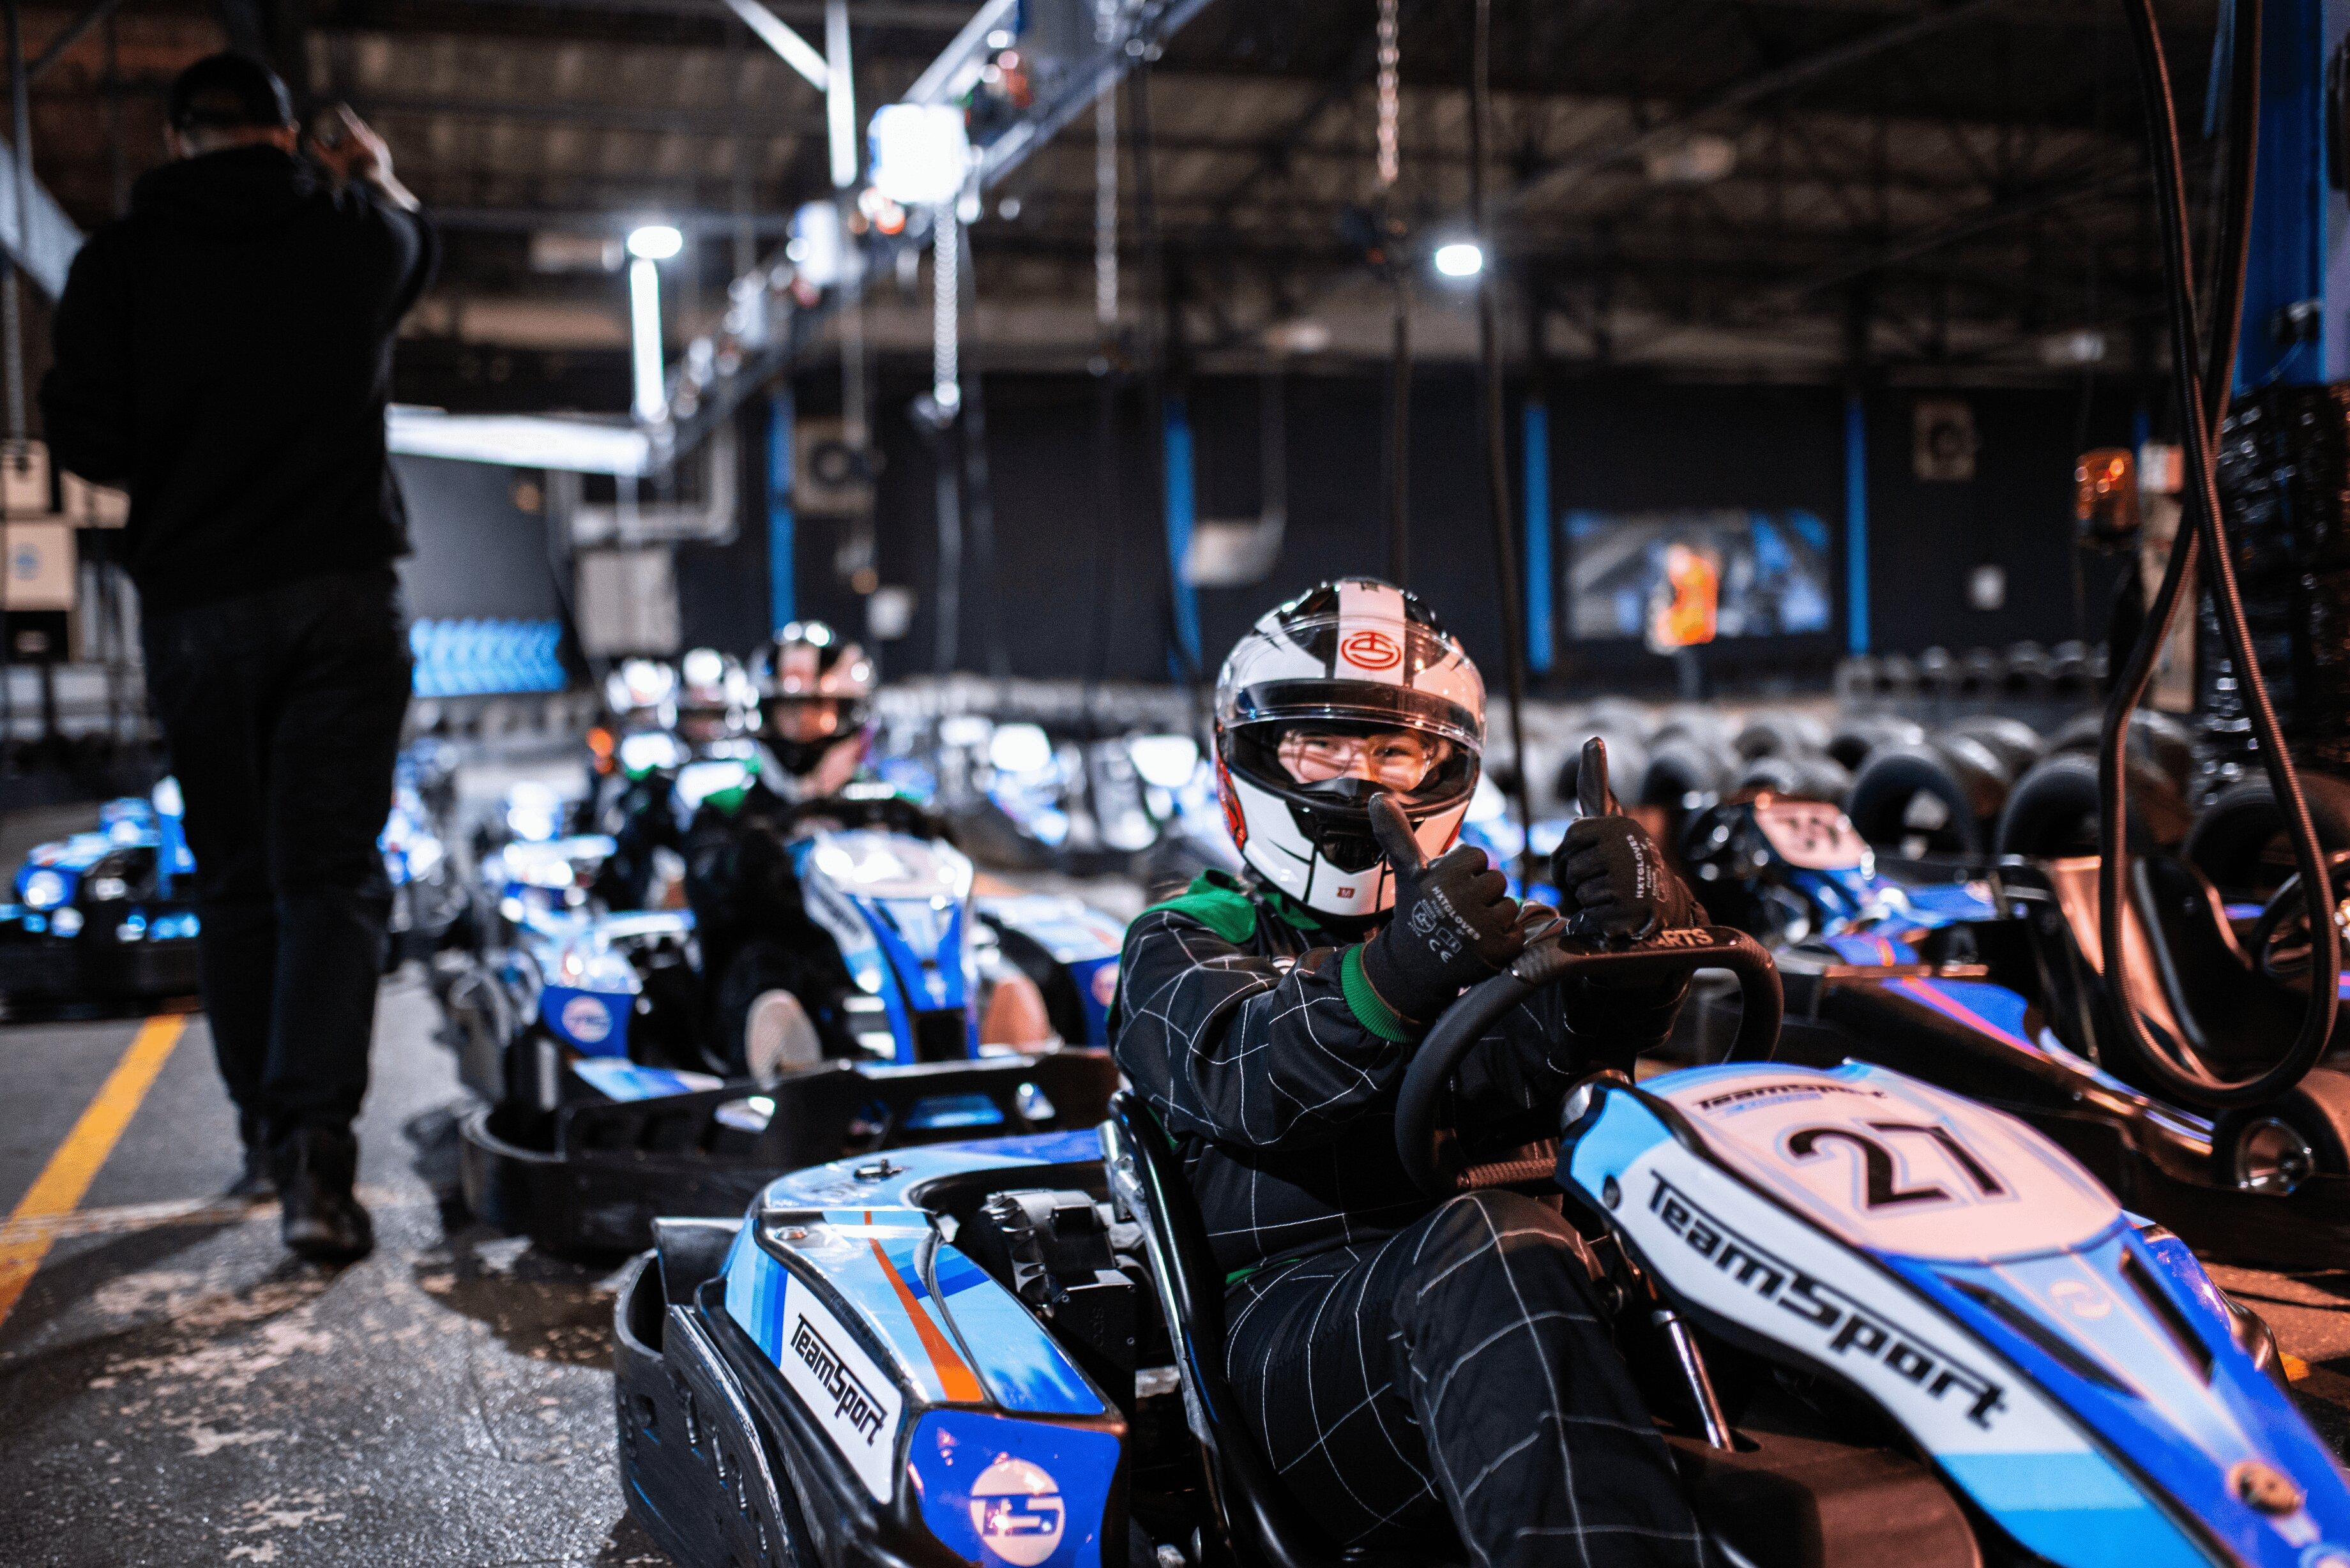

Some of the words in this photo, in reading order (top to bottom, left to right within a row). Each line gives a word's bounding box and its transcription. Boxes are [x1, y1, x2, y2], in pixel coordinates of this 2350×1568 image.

[1626, 834, 1645, 898] HXTGLOVES
[1432, 886, 1482, 940] HXTGLOVES
[1642, 928, 1715, 947] ARTS
[1788, 1122, 2005, 1210] 27
[1648, 1168, 2008, 1431] TeamSport
[790, 1312, 888, 1448] TeamSport
